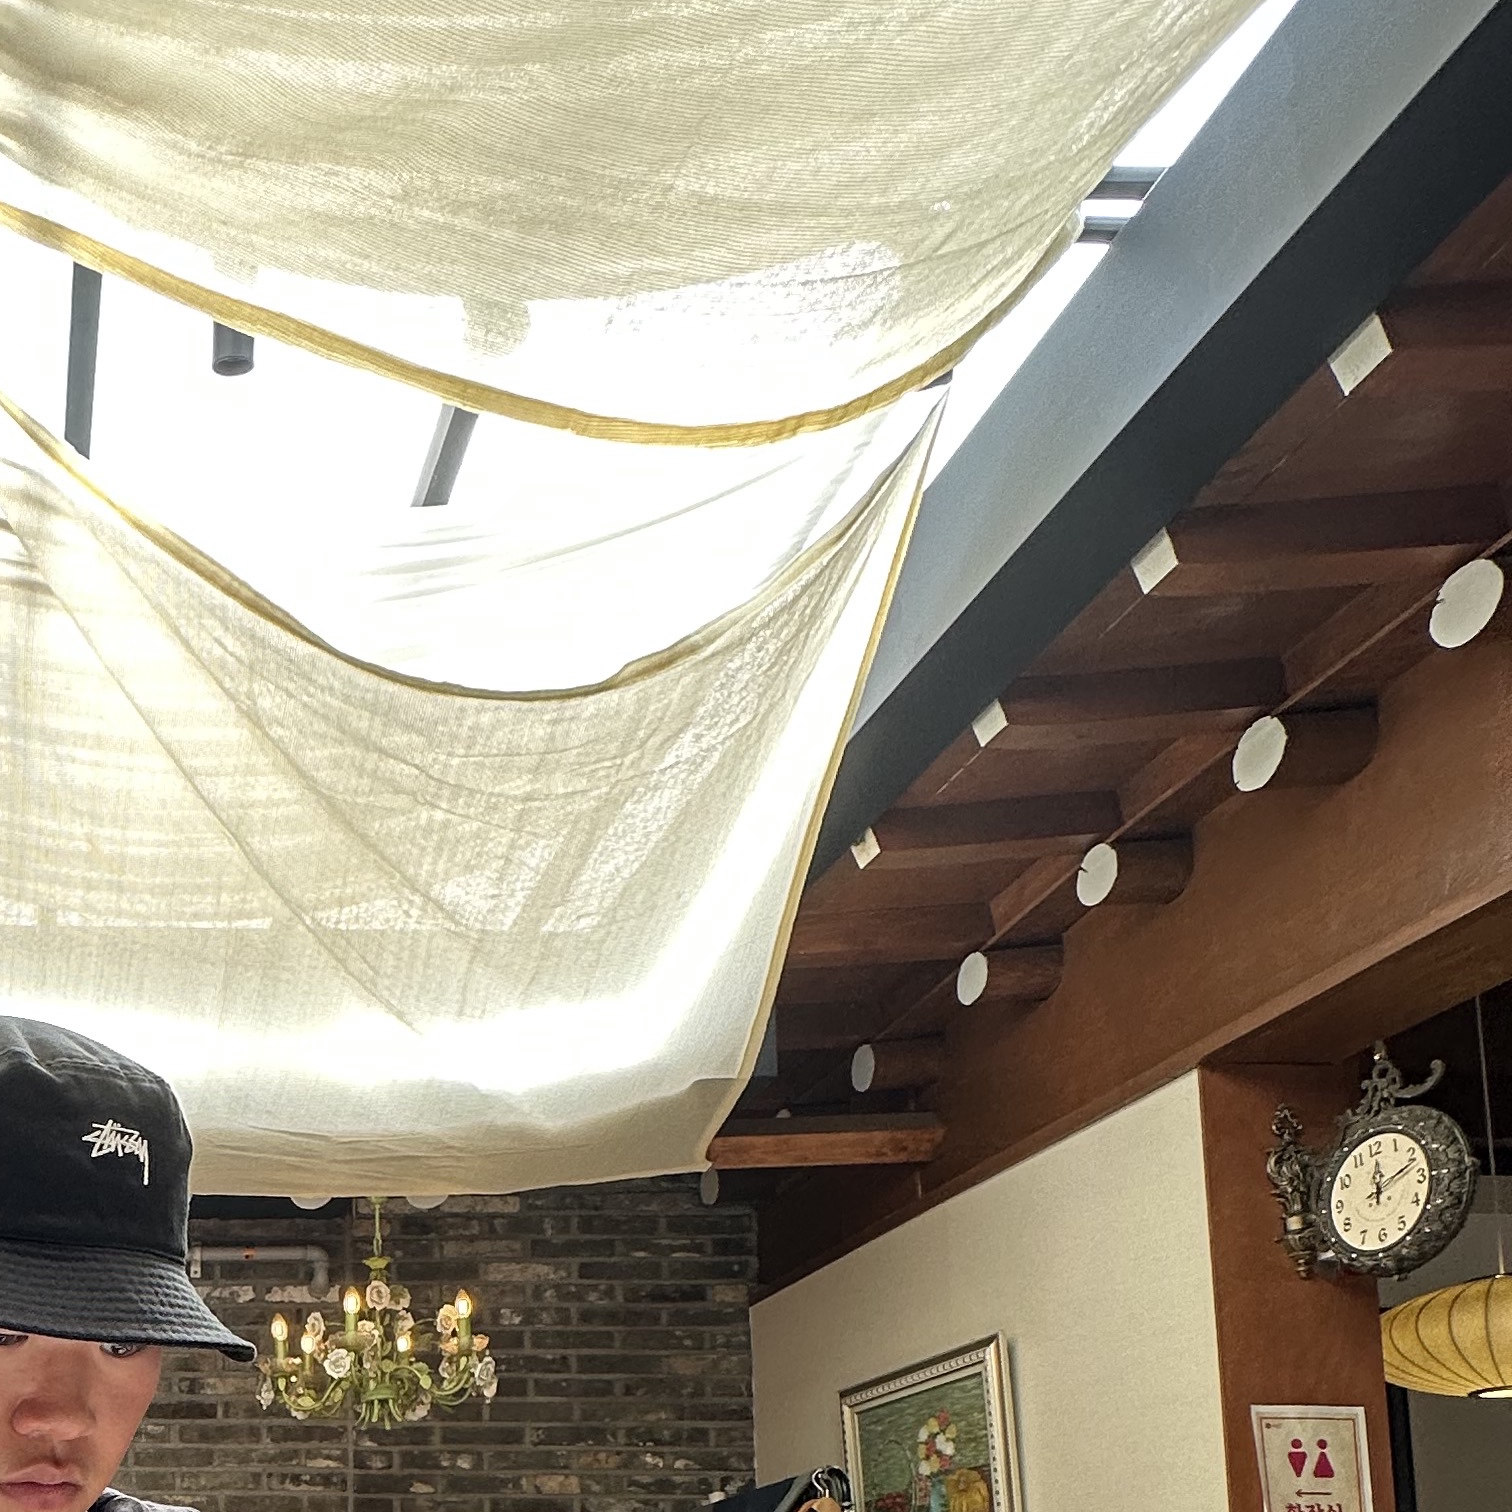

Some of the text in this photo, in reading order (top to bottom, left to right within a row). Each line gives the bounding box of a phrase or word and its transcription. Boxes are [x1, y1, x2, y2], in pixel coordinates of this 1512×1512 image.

[1368, 1140, 1382, 1158] 12
[1392, 1138, 1399, 1152] 1
[1353, 1152, 1364, 1169] 11
[1407, 1147, 1417, 1163] 2
[1339, 1173, 1352, 1191] 10
[1416, 1167, 1427, 1184] 3
[1335, 1199, 1344, 1214] 9
[1411, 1191, 1421, 1207] 4
[1343, 1217, 1352, 1232] 8
[1397, 1215, 1406, 1231] 5
[1359, 1228, 1368, 1245] 7
[1378, 1227, 1388, 1243] 6
